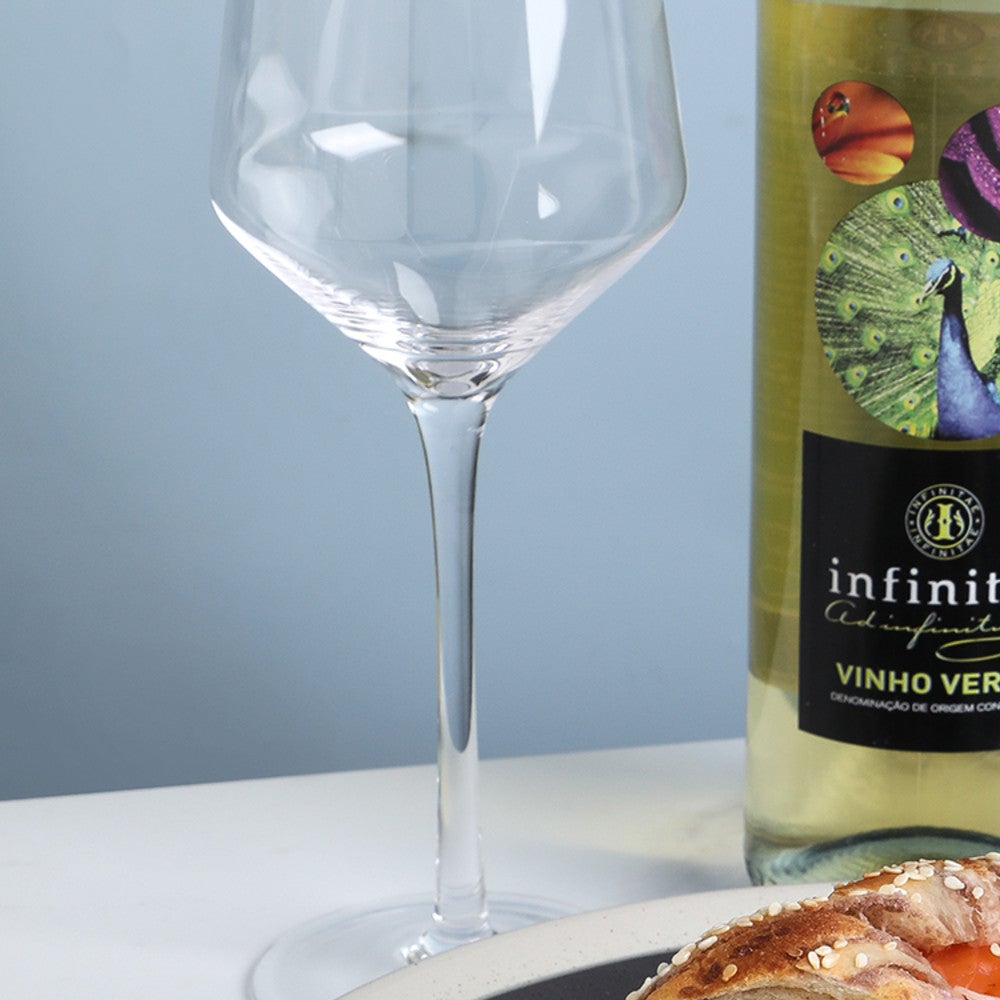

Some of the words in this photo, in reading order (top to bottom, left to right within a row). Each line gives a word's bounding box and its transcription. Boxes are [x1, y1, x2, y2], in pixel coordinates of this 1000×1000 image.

[836, 662, 932, 694] VINHO
[830, 691, 910, 711] DENOMINAÇÃO
[912, 703, 928, 712] DE
[930, 703, 975, 713] ORIGEM
